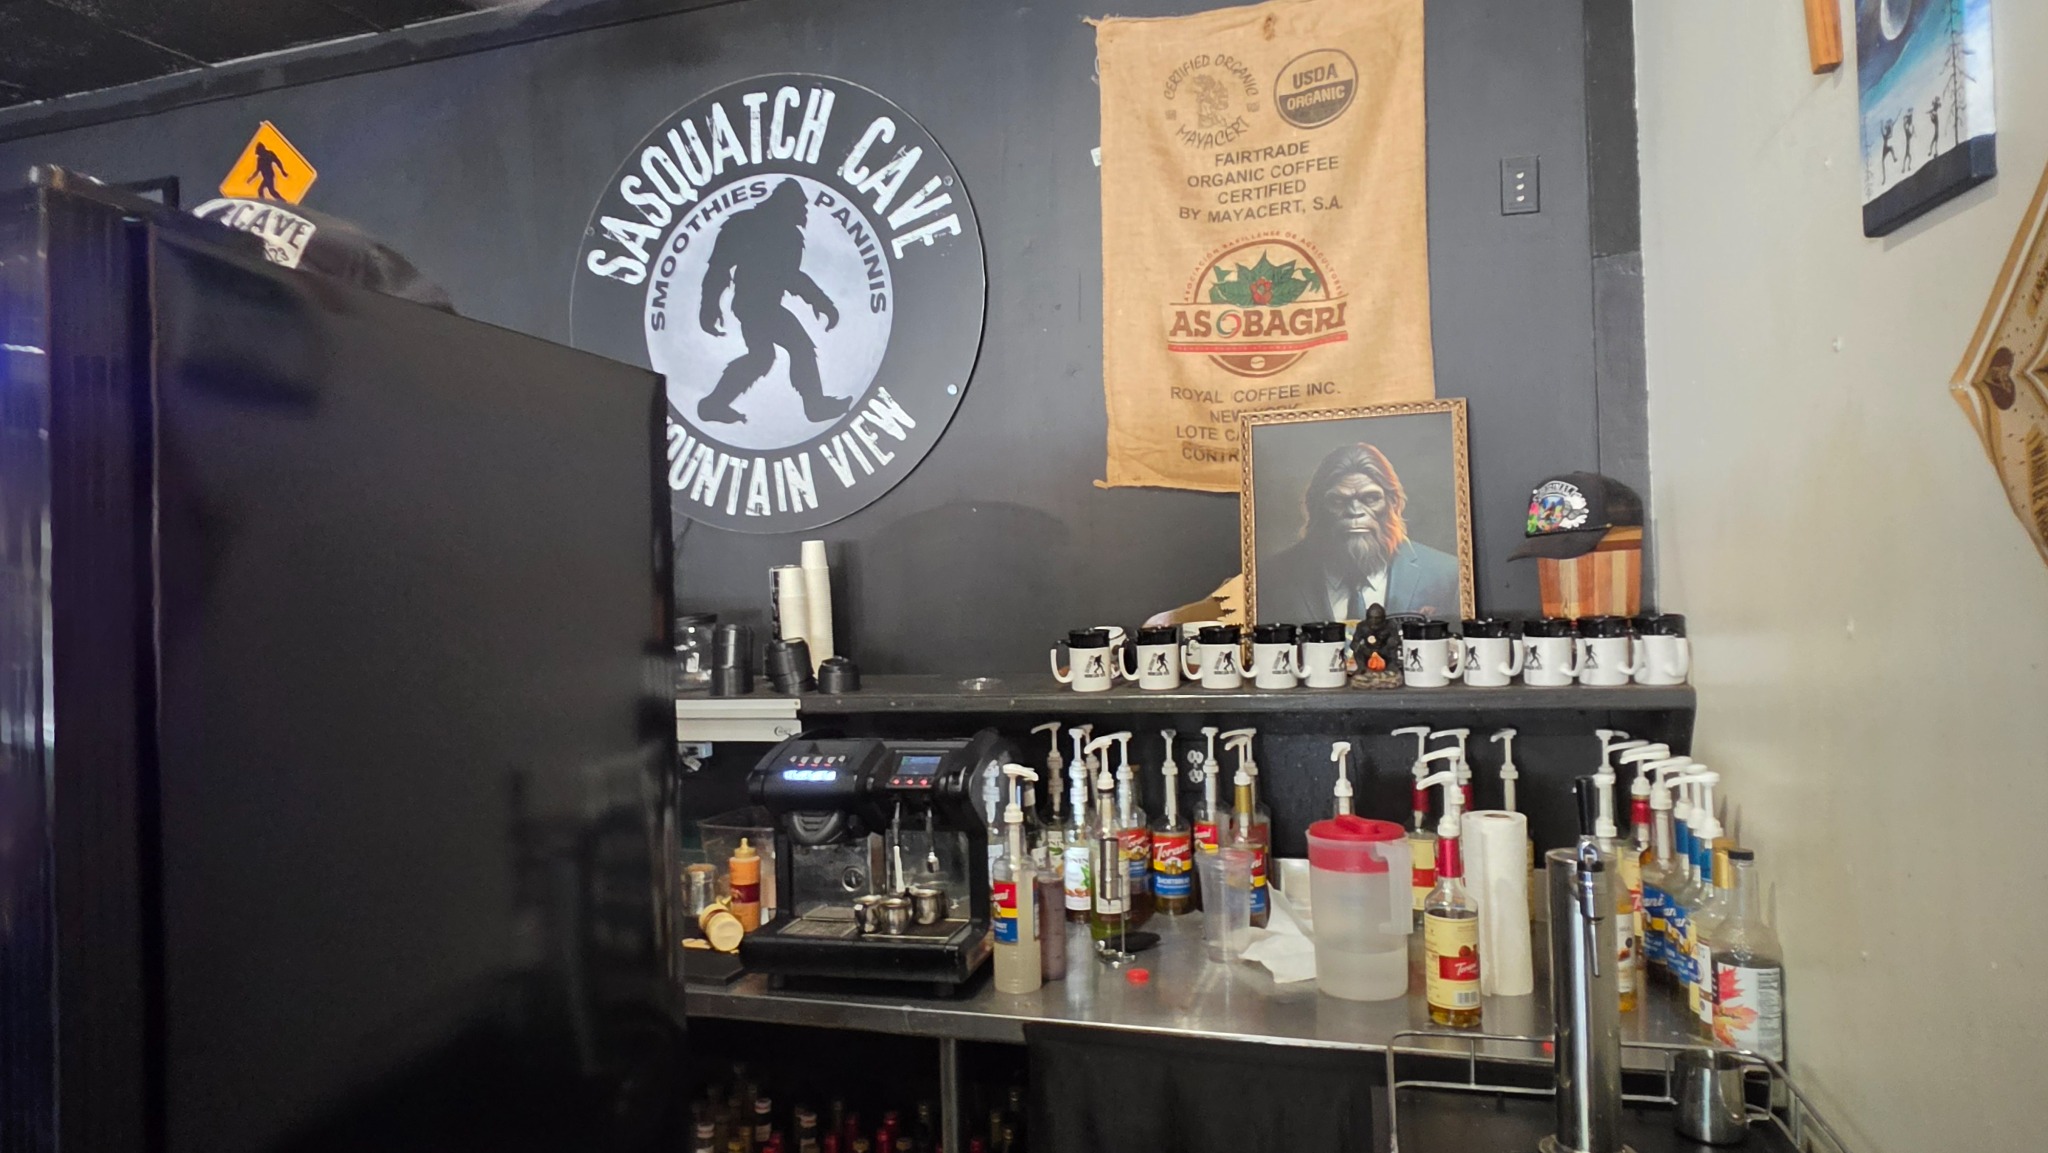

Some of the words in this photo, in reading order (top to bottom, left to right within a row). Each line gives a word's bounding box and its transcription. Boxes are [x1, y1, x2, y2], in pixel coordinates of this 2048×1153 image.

[1164, 54, 1210, 100] CERTIFIED
[1215, 54, 1259, 96] ORGANIC
[1292, 63, 1338, 89] USDA
[1286, 85, 1346, 111] ORGANIC
[1176, 115, 1250, 150] MAYACERT
[1215, 140, 1311, 167] FAIRTRADE
[587, 86, 835, 286] SASQUATCH
[842, 116, 961, 260] CAVE
[1187, 168, 1265, 188] ORGANIC
[1270, 155, 1340, 179] COFFEE
[1217, 179, 1307, 205] CERTIFIED
[1179, 206, 1201, 221] BY
[1208, 199, 1307, 223] MAYACERT,
[1313, 195, 1344, 211] S.A.
[651, 180, 768, 332] SMOOTHIES
[814, 190, 887, 315] PANINIS
[1169, 301, 1347, 339] ASOBAGRI
[1170, 385, 1223, 404] ROYAL
[1233, 384, 1301, 404] COFFEE
[1306, 381, 1341, 397] INC.
[1176, 425, 1218, 440] LOTE
[1225, 429, 1240, 442] C
[667, 416, 819, 516] OUNTAIN
[819, 386, 916, 488] VIEW
